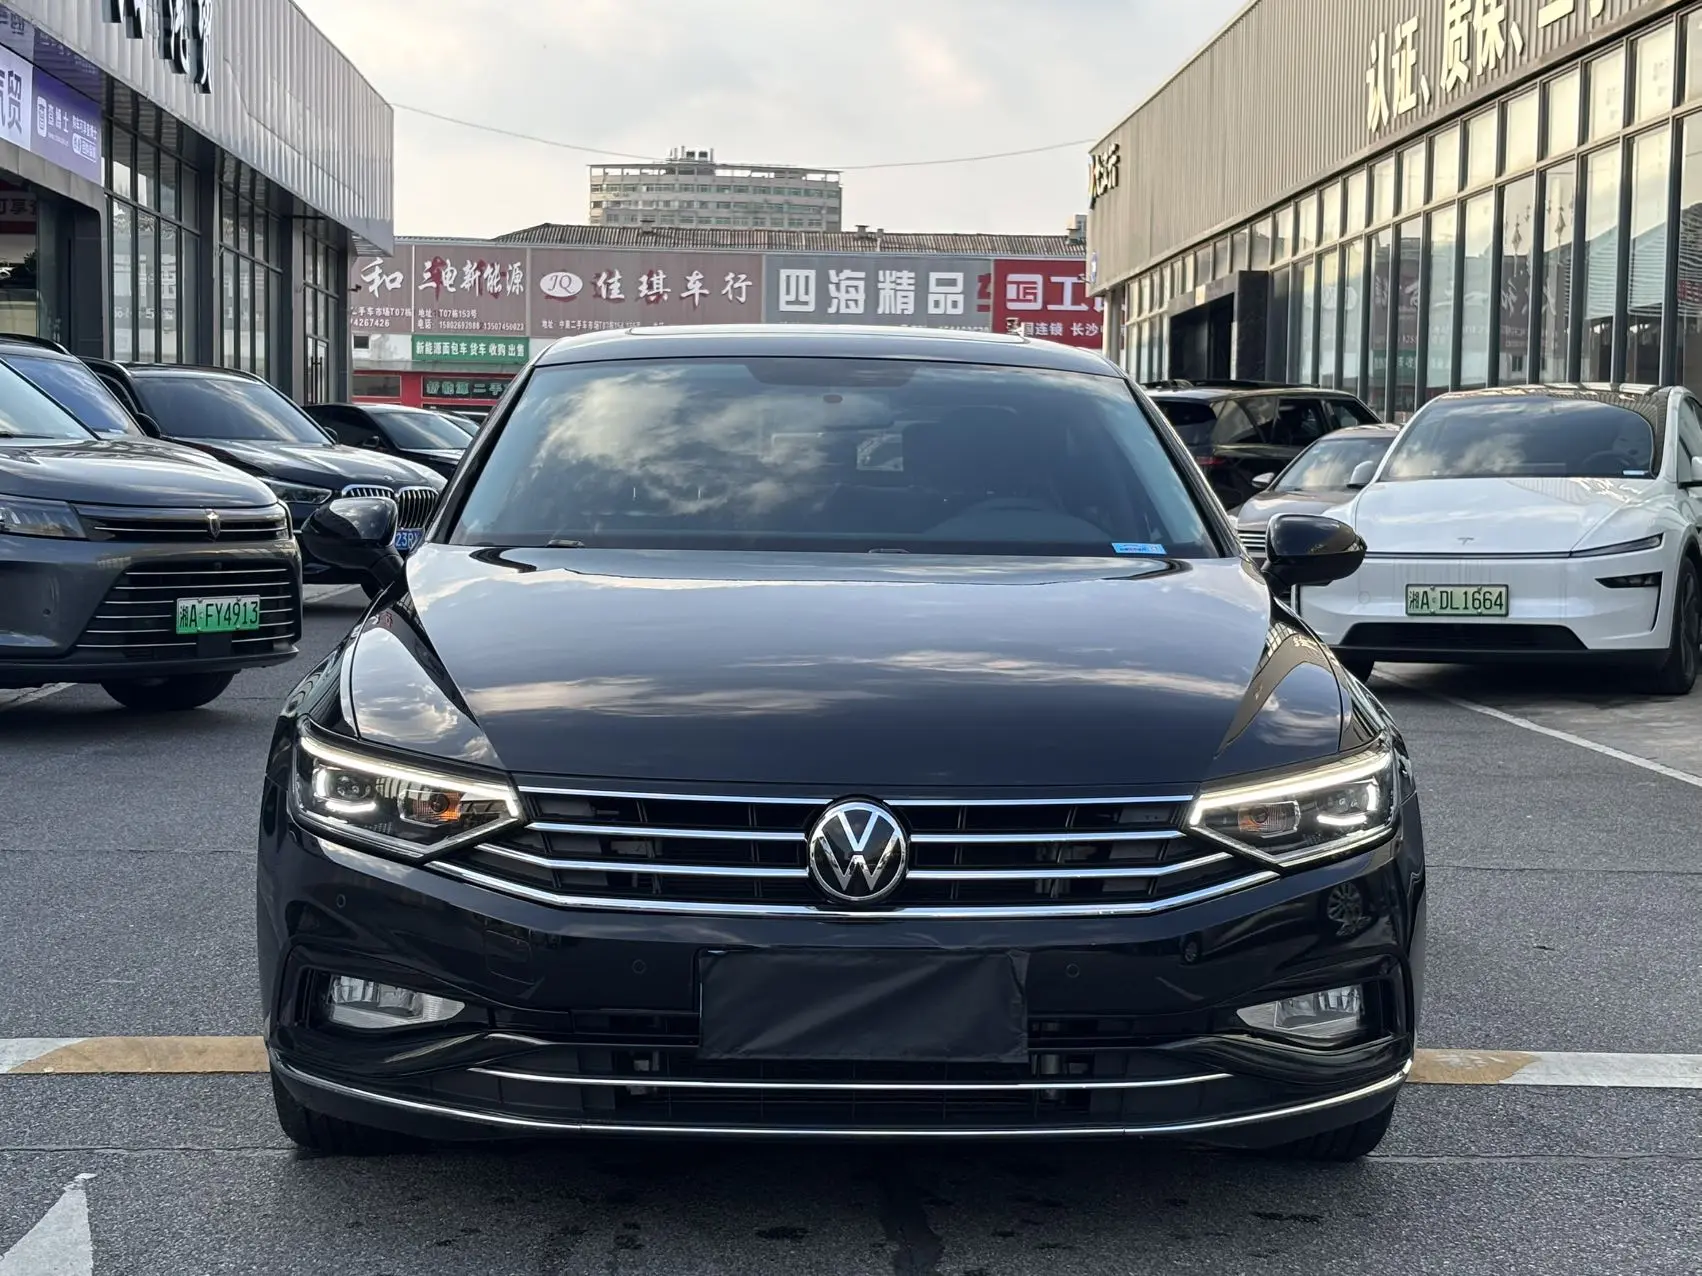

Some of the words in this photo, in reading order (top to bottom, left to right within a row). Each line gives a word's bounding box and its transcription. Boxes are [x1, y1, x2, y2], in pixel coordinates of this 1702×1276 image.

[1366, 0, 1604, 133] 认证、质保、
[361, 257, 404, 298] 和
[599, 268, 753, 307] 佳琪车行
[350, 318, 390, 328] 4267426
[1009, 321, 1063, 336] 国连锁
[1070, 321, 1104, 336] 长沙
